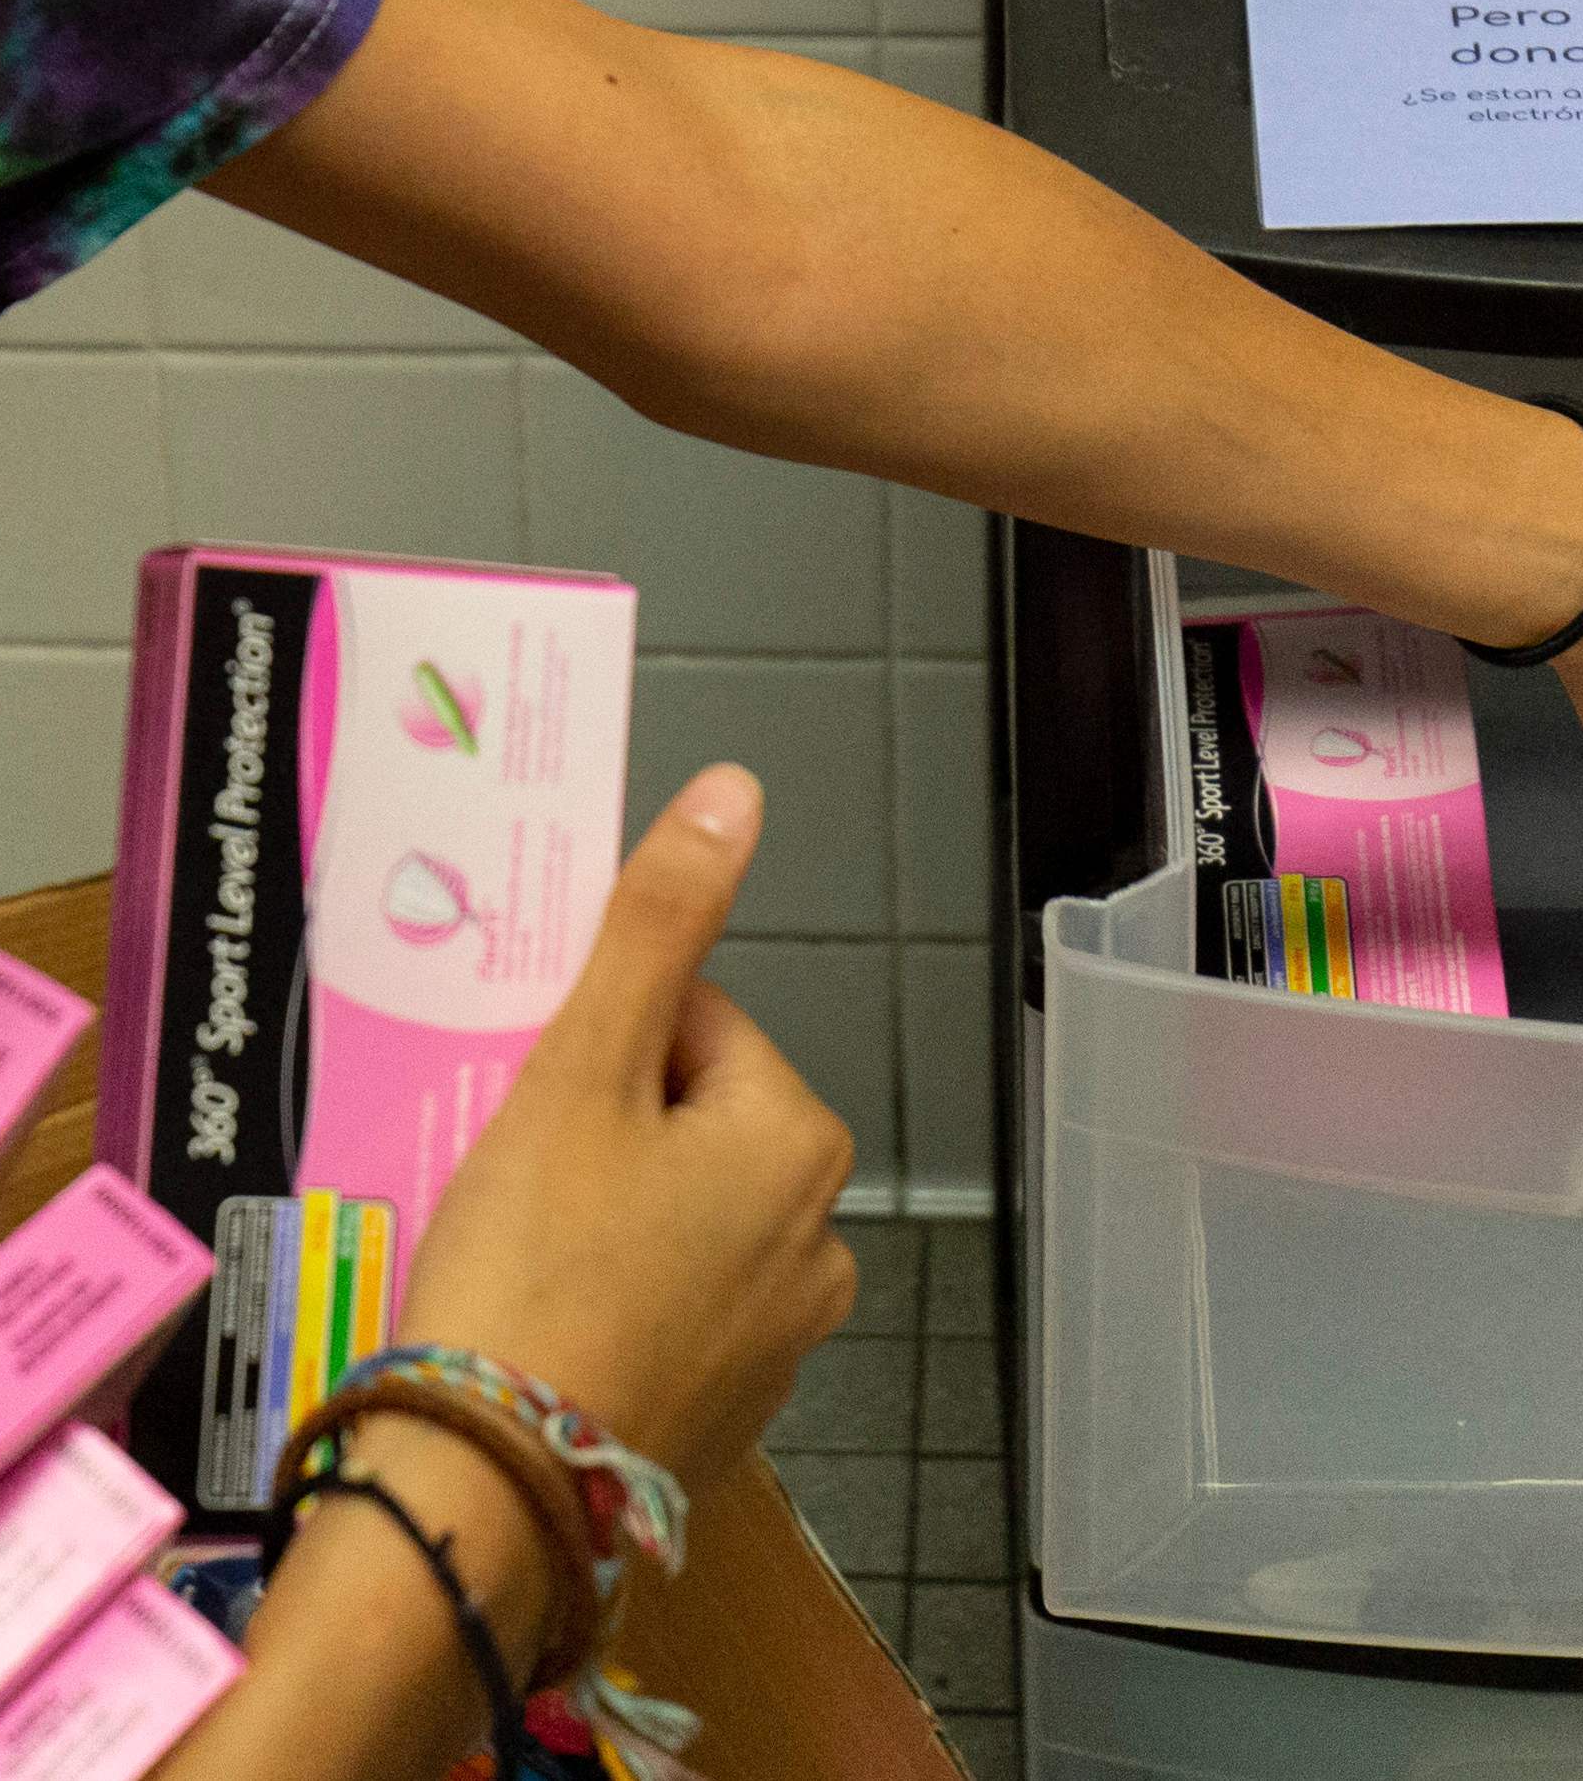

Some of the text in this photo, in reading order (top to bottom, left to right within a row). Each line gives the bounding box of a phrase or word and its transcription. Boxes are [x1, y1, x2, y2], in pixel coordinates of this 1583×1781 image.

[1450, 6, 1571, 28] Pero
[1402, 87, 1457, 107] ¿Se
[1467, 87, 1553, 102] estan
[1191, 727, 1221, 770] Level
[1195, 771, 1233, 820] Sport
[206, 822, 261, 938] Level
[195, 934, 259, 1056] Sport
